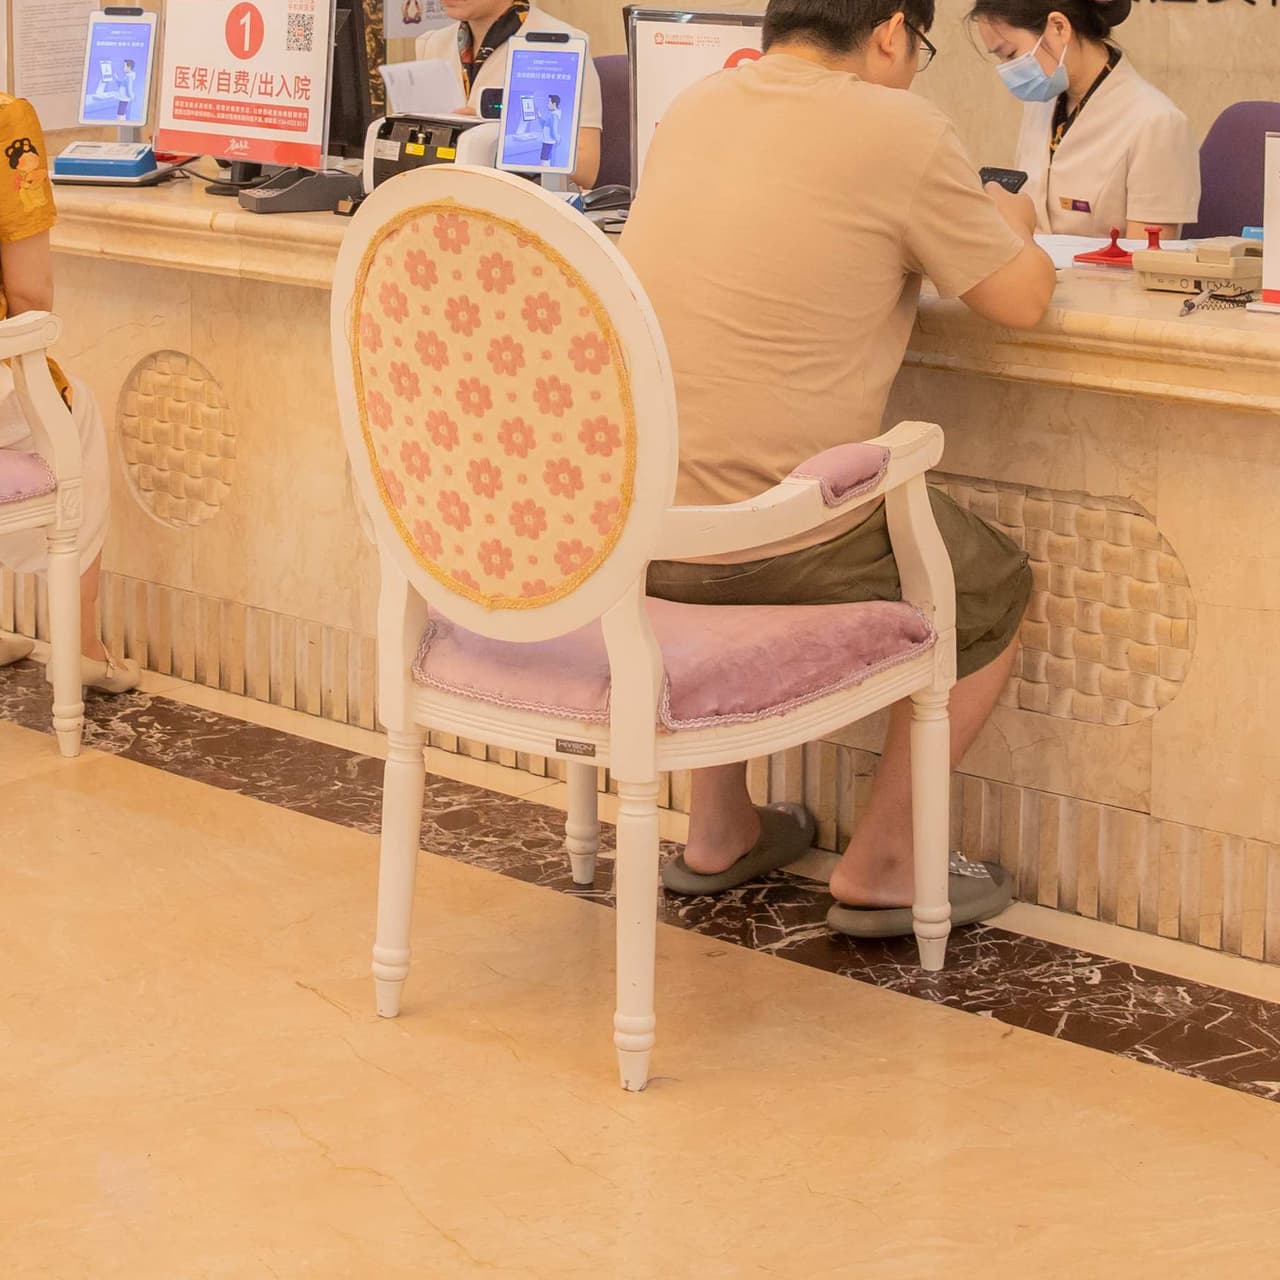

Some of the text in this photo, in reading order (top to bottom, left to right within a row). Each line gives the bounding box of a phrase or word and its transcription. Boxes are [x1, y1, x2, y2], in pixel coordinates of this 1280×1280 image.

[239, 10, 251, 52] 1
[174, 65, 312, 101] 医保/自费/出入院
